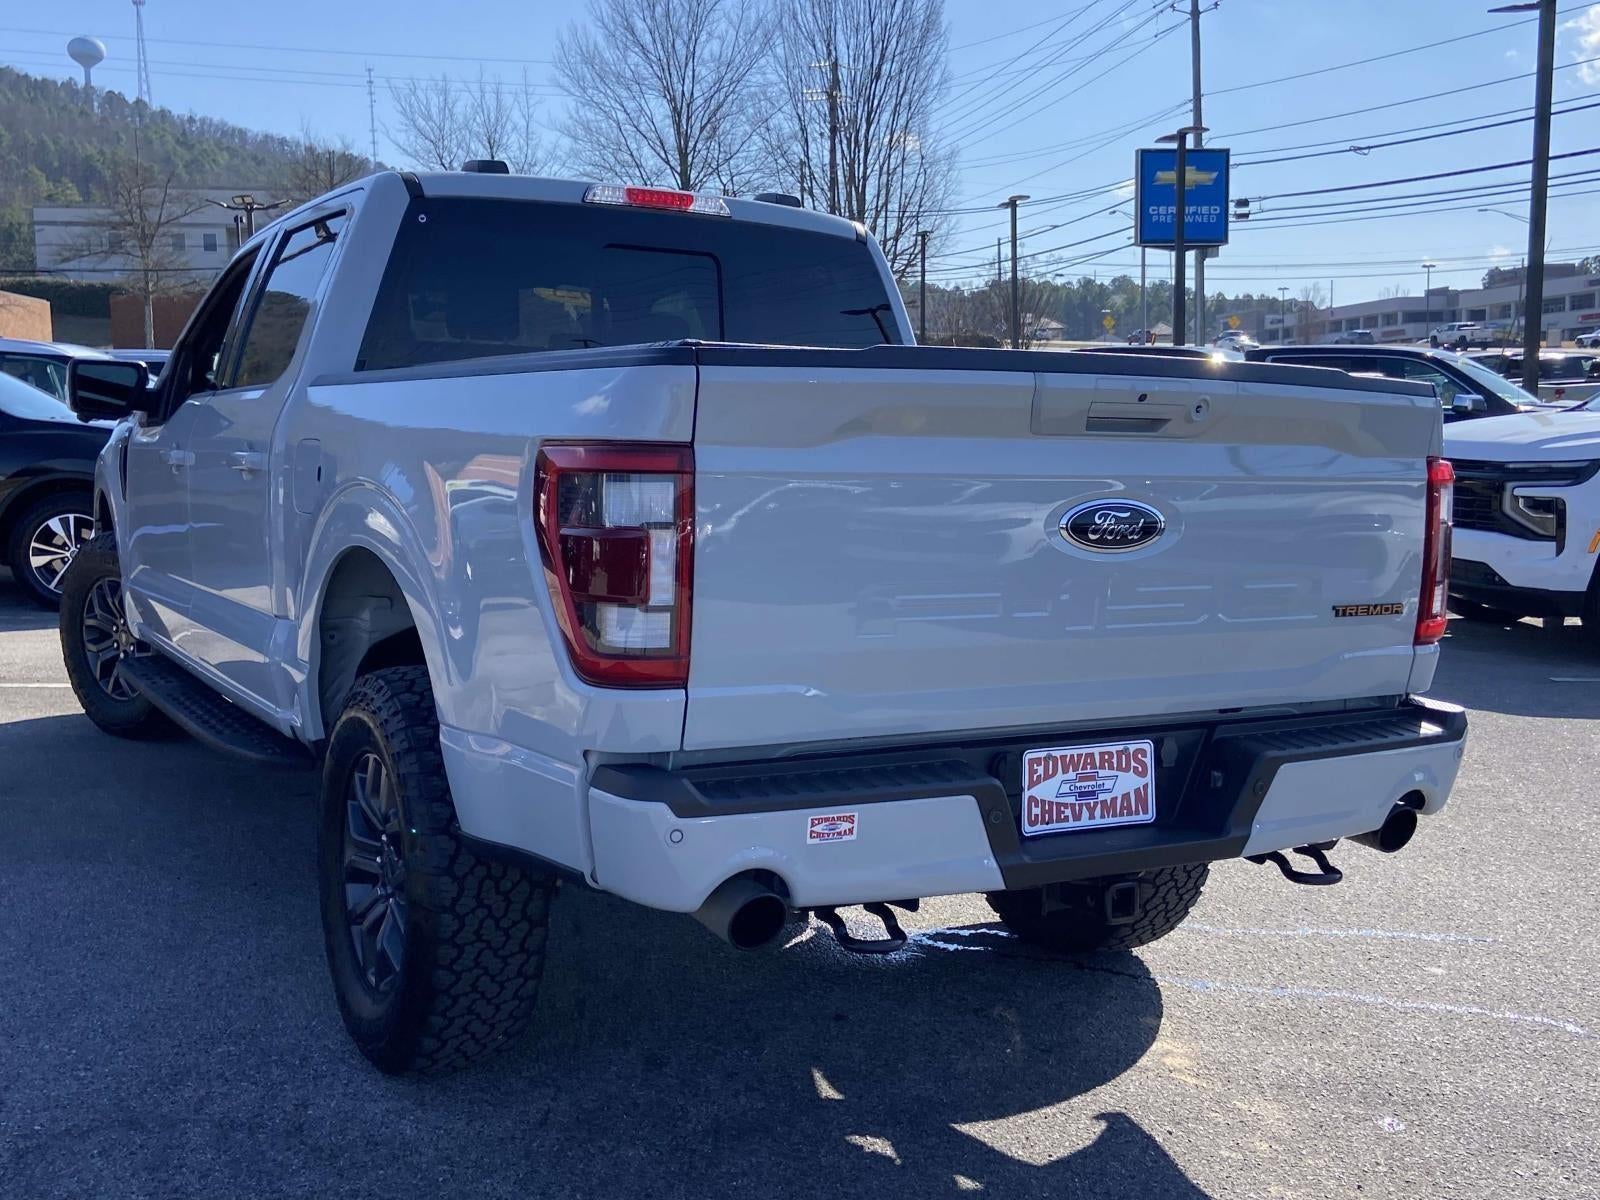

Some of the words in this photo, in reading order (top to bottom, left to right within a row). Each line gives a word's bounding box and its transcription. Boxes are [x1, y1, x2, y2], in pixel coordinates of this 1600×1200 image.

[1149, 206, 1220, 214] CERIFIED
[1152, 215, 1216, 223] PRE-WNED
[1088, 510, 1144, 540] Ford
[1332, 602, 1404, 617] TREMOR
[1027, 748, 1149, 791] EDWARDS
[1068, 782, 1105, 792] Chevrolet
[1027, 782, 1149, 827] CHEVYMAN
[810, 814, 855, 828] EDWARDS
[810, 826, 854, 839] CHEVYMAN
